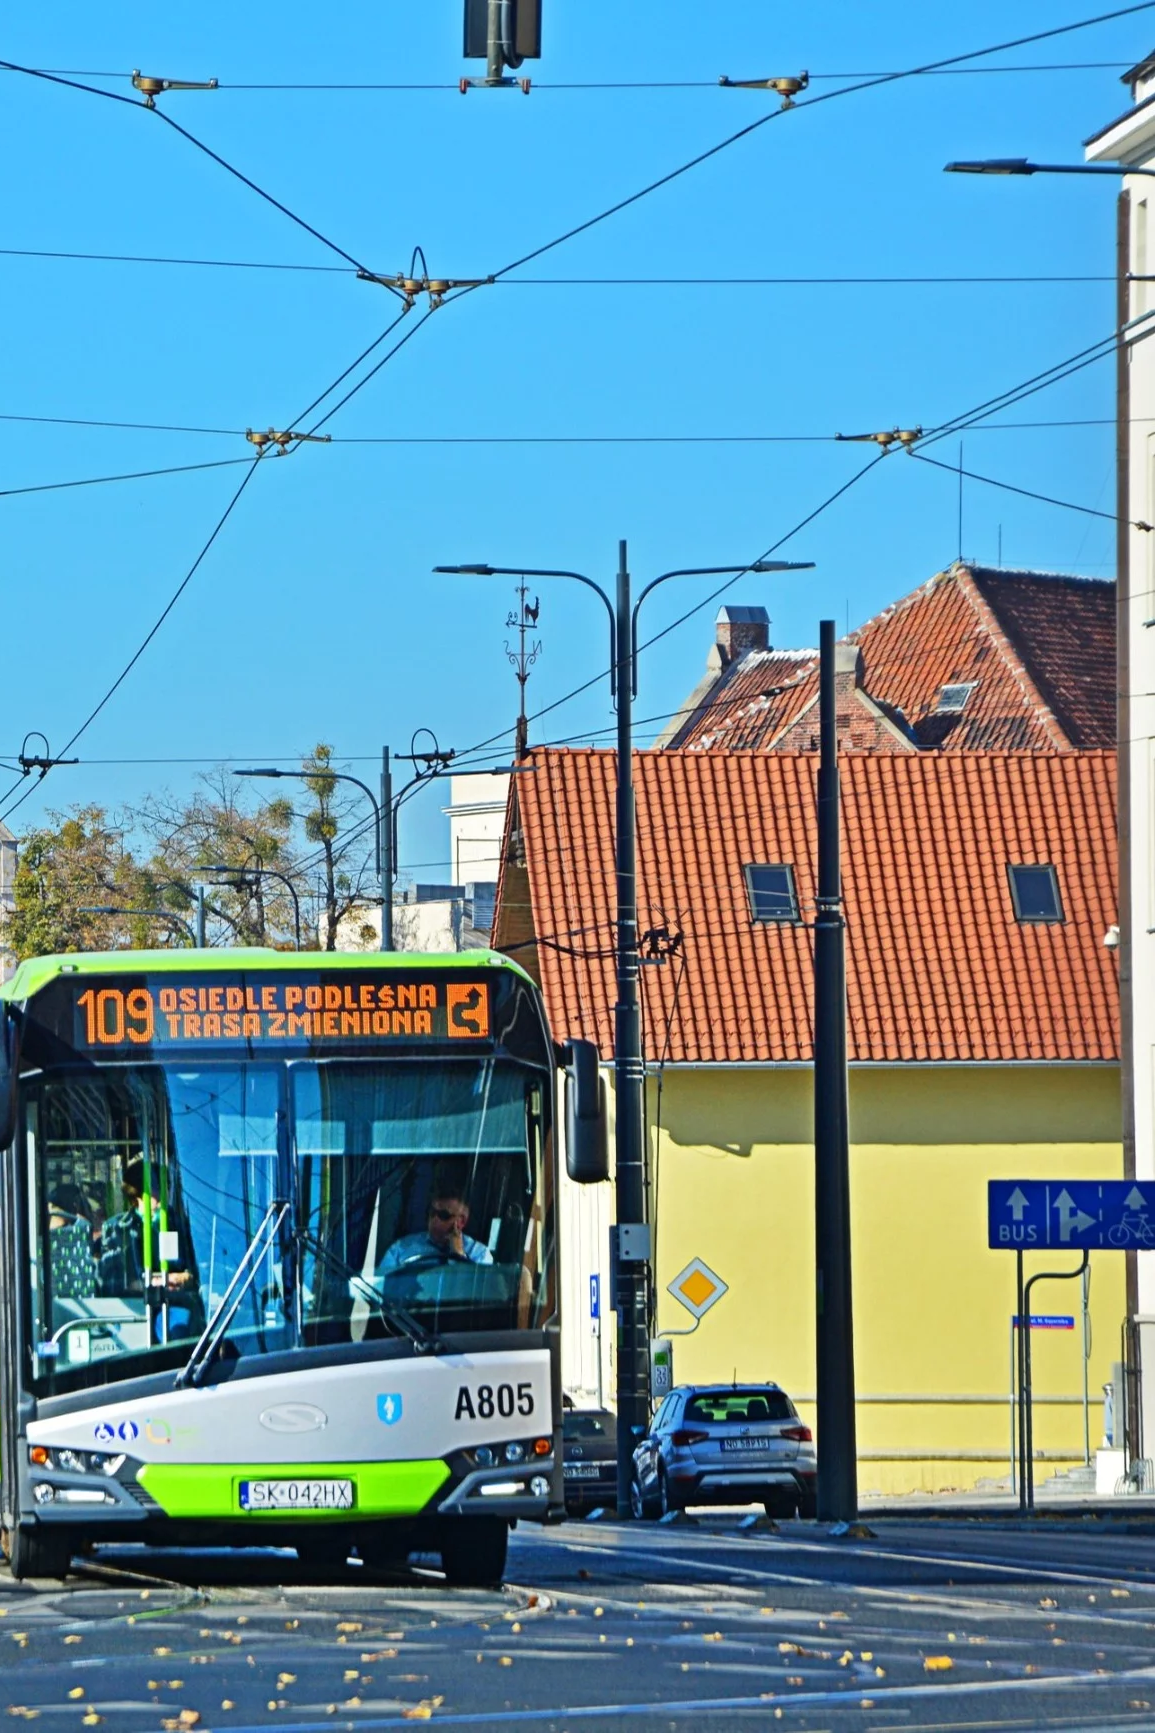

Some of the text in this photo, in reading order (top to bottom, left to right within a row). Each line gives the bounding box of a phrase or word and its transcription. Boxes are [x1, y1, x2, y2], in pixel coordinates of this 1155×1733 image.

[159, 984, 437, 1012] OSIEDLE PODLEŚNA
[77, 988, 154, 1045] 109
[165, 1010, 432, 1039] TRASA ZMIENIONA
[999, 1224, 1038, 1242] BUS
[454, 1382, 535, 1420] A805
[253, 1482, 348, 1502] SK 042HX
